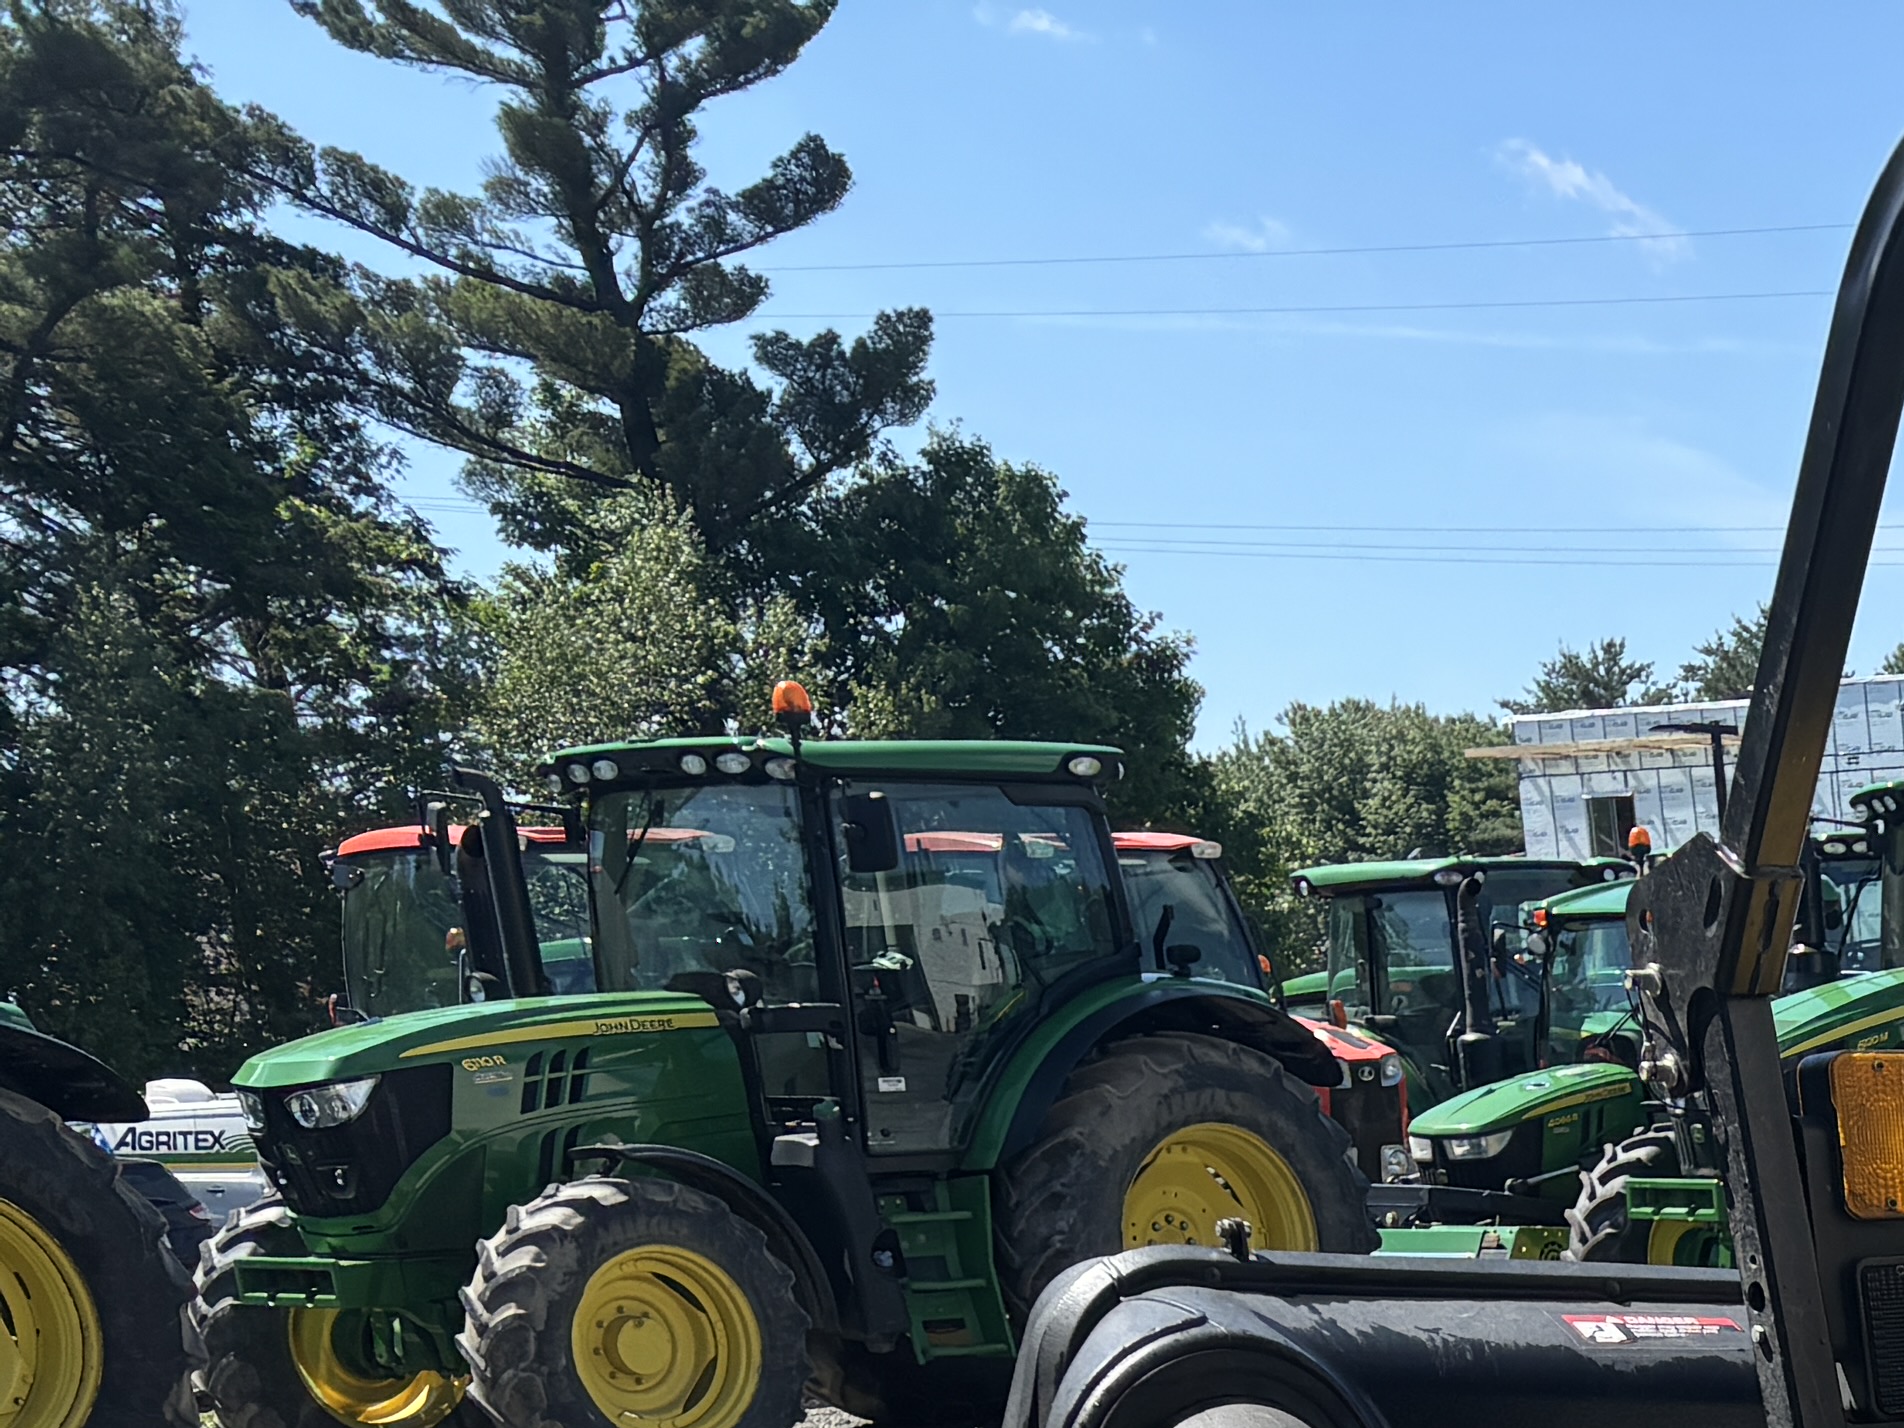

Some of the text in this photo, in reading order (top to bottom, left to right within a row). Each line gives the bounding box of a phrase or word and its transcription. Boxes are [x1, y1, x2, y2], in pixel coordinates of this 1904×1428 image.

[593, 1018, 674, 1035] JOHN DEERE
[113, 1126, 227, 1151] AGRITEX
